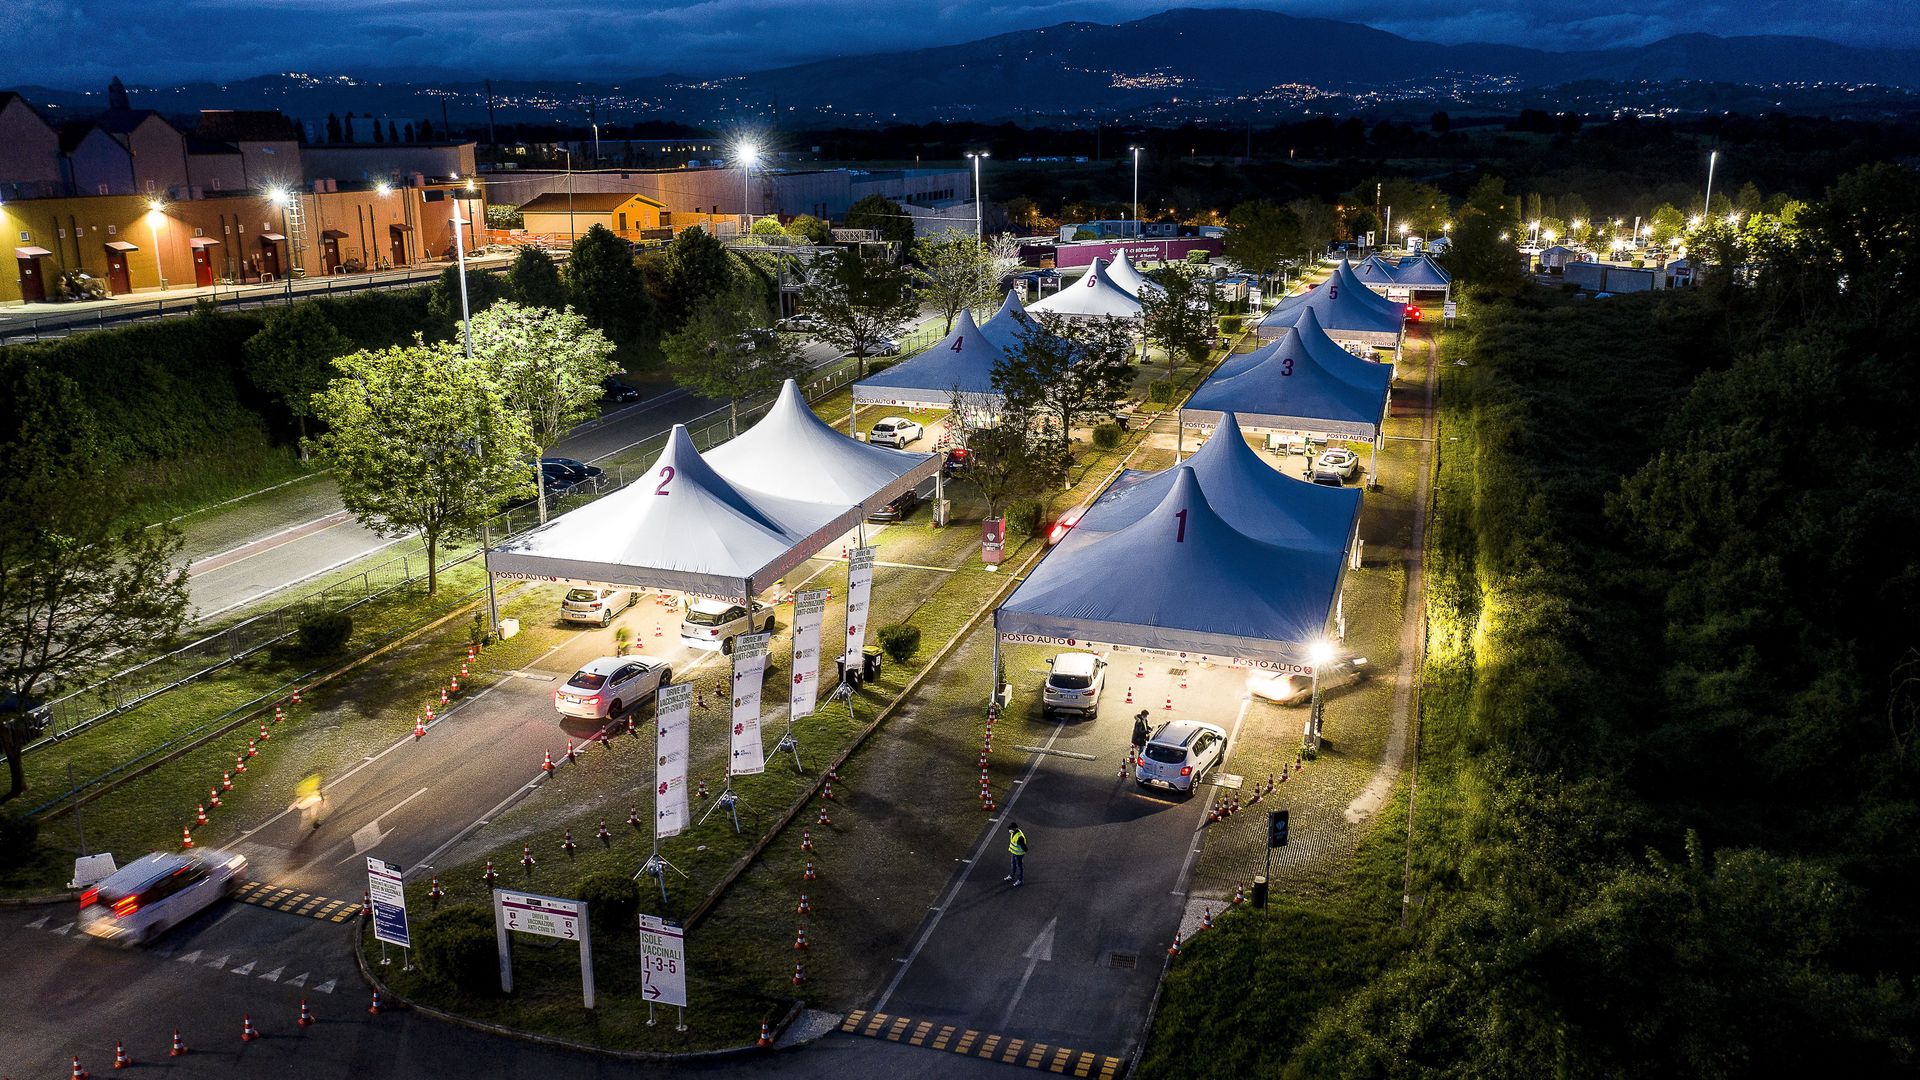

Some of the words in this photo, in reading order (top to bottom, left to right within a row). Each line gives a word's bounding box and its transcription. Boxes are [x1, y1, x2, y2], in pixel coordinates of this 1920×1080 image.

[1365, 265, 1373, 275] 7
[1087, 275, 1097, 287] 6
[1329, 286, 1338, 299] 5
[951, 336, 963, 353] 4
[1281, 358, 1294, 376] 3
[656, 466, 674, 495] 2
[1175, 509, 1187, 542] 1
[495, 571, 523, 580] POSTO
[525, 573, 548, 581] AUTO
[684, 590, 712, 599] POSTO
[714, 594, 738, 604] AUTO
[1001, 633, 1035, 643] POSTO
[1037, 635, 1066, 645] AUTO
[1233, 657, 1268, 668] POSTO
[1270, 662, 1302, 673] AUTO
[527, 918, 555, 928] VACCINAZIONE
[532, 912, 543, 920] DRIVE
[642, 932, 663, 946] ISOLE
[642, 944, 682, 960] VACCINALI
[644, 955, 677, 974] 1-3-5
[643, 970, 651, 984] 7
